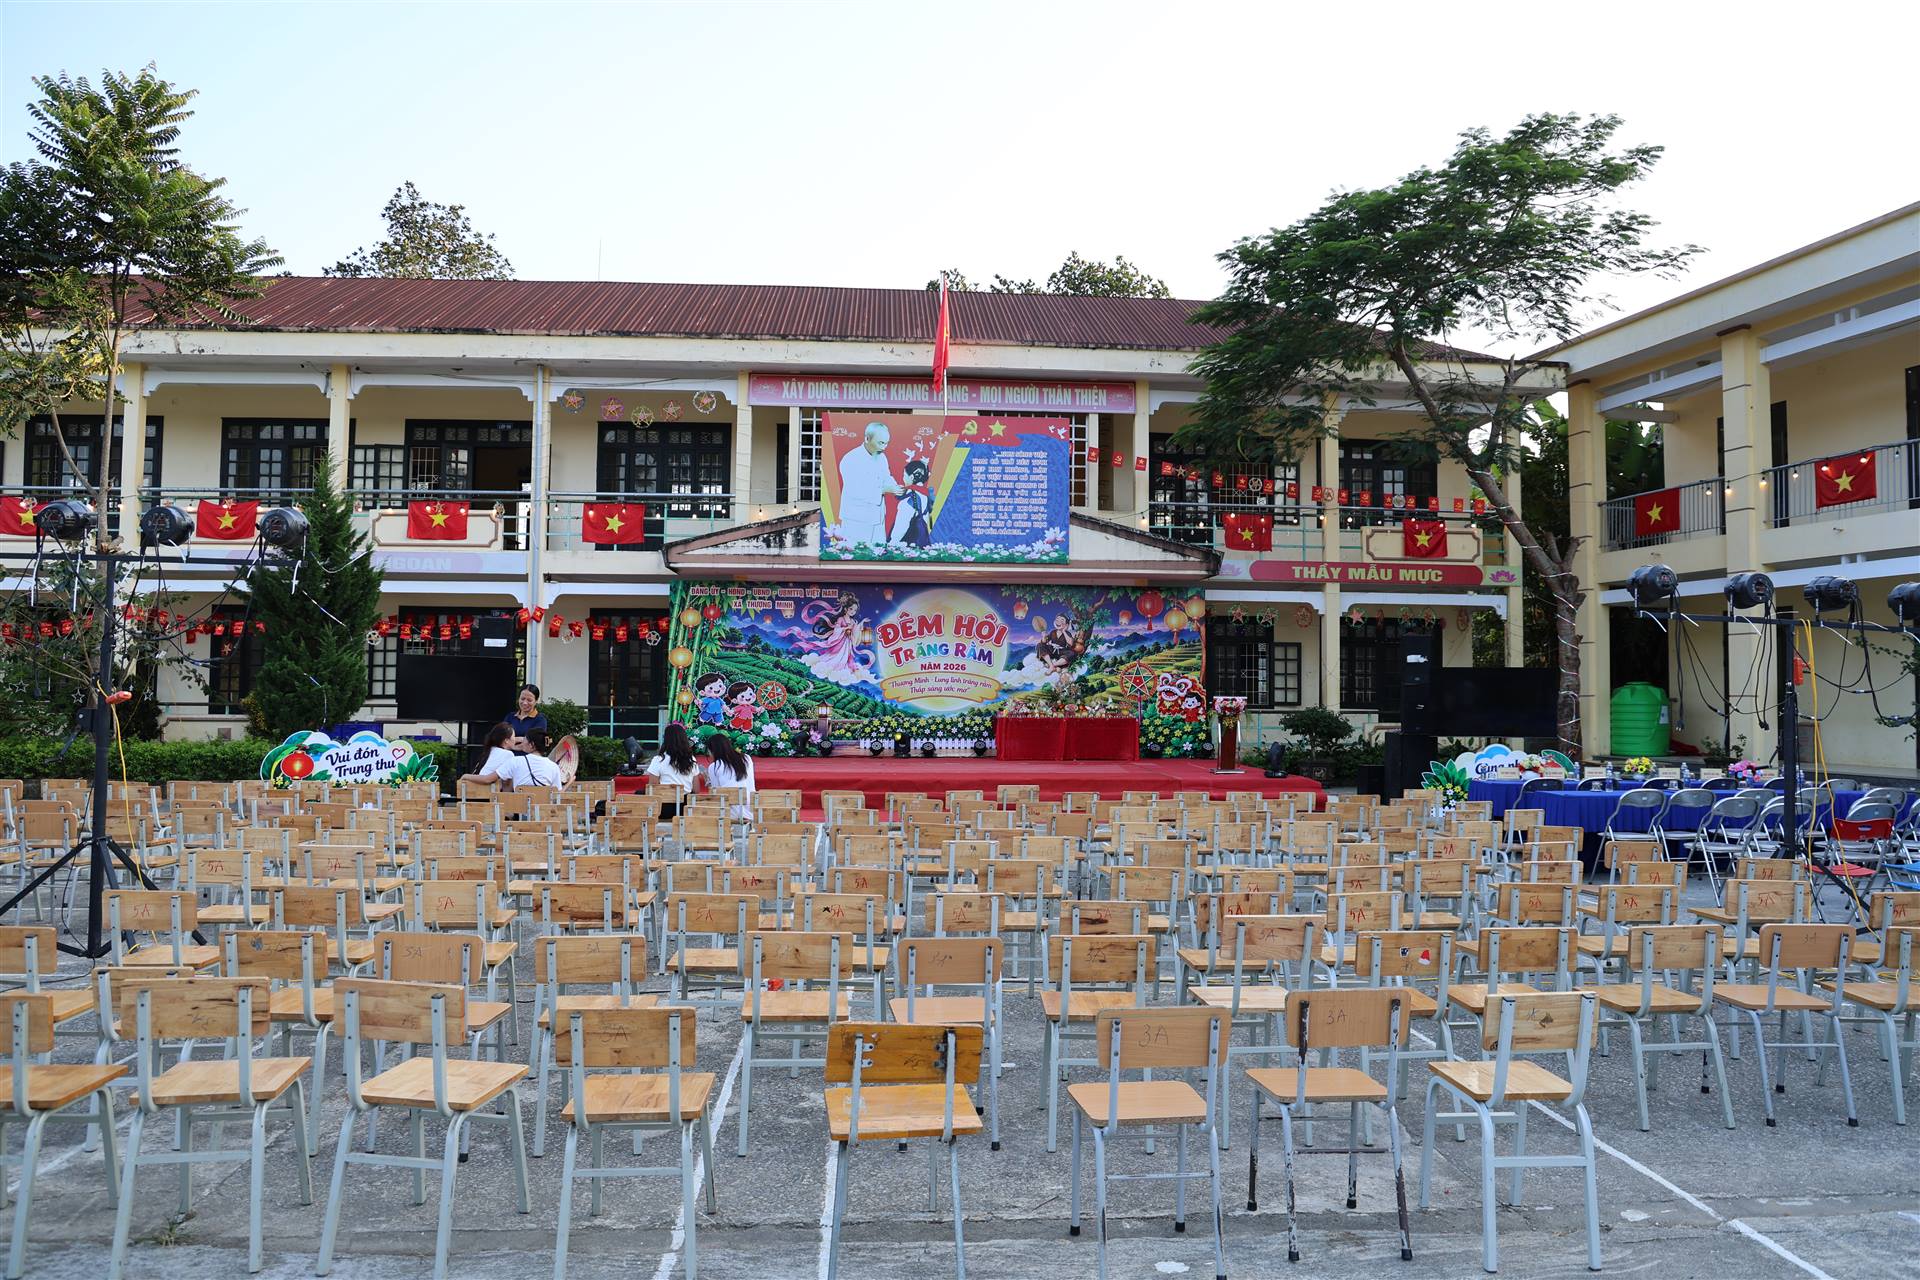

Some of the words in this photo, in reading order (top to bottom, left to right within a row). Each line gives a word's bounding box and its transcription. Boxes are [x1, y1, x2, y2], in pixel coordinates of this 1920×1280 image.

[782, 378, 805, 399] XÂY
[807, 380, 839, 403] DỰNG
[842, 379, 887, 401] TRƯỜNG
[891, 384, 929, 401] KHANG
[980, 385, 1000, 407] MỌI
[1006, 384, 1039, 405] NGƯỜI
[1042, 385, 1071, 405] THÂN
[1075, 387, 1107, 409] THIỆN
[1348, 564, 1392, 580] MẪU
[1400, 569, 1443, 584] MỰC
[775, 601, 794, 609] MINH
[878, 612, 944, 648] ĐÊM
[953, 613, 1008, 647] HỘI
[890, 642, 950, 666] TRĂNG
[954, 641, 994, 667] RẰM
[920, 662, 941, 671] NĂM
[944, 663, 966, 671] 2026
[325, 751, 351, 766] Vui
[353, 747, 380, 760] đón
[335, 764, 373, 777] Trung
[375, 758, 396, 769] thu
[438, 896, 455, 911] 5A
[1326, 1009, 1348, 1026] 3A
[1138, 1024, 1170, 1048] 3A
